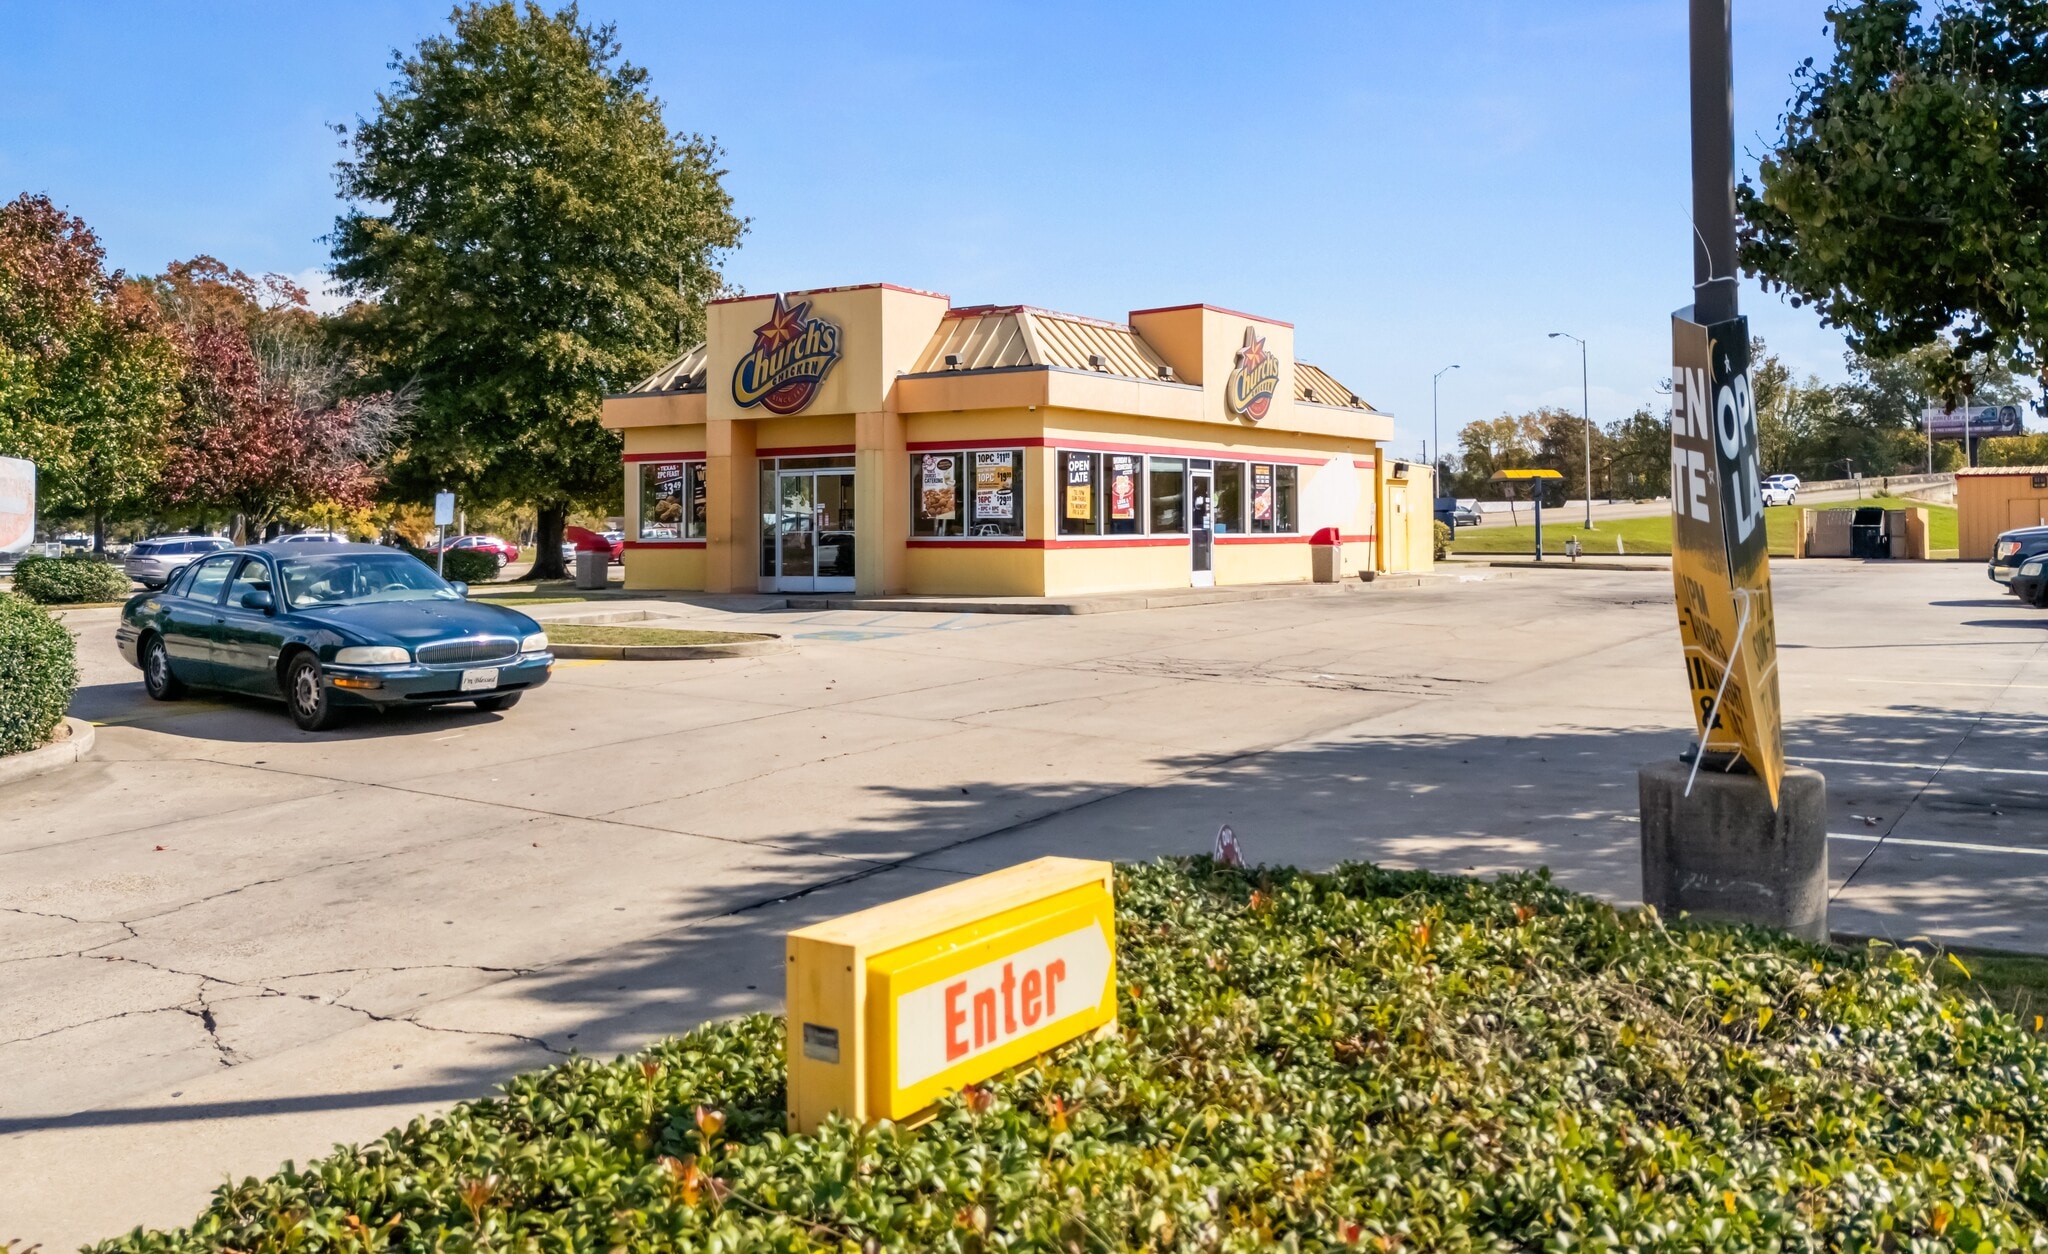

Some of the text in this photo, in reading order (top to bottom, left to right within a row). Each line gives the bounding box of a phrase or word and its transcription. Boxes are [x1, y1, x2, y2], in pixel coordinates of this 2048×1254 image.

[734, 321, 834, 403] Church's
[771, 361, 819, 386] CHICKEN
[1234, 351, 1279, 409] Church's
[977, 453, 995, 463] 10PC
[1068, 460, 1090, 472] OPEN
[667, 470, 680, 478] FEAST
[1070, 471, 1089, 484] LATE
[1672, 446, 1711, 524] TE
[1731, 449, 1764, 545] LA
[463, 676, 496, 685] I'm Blessed
[1700, 696, 1723, 730] &
[944, 958, 1066, 1063] Enter
